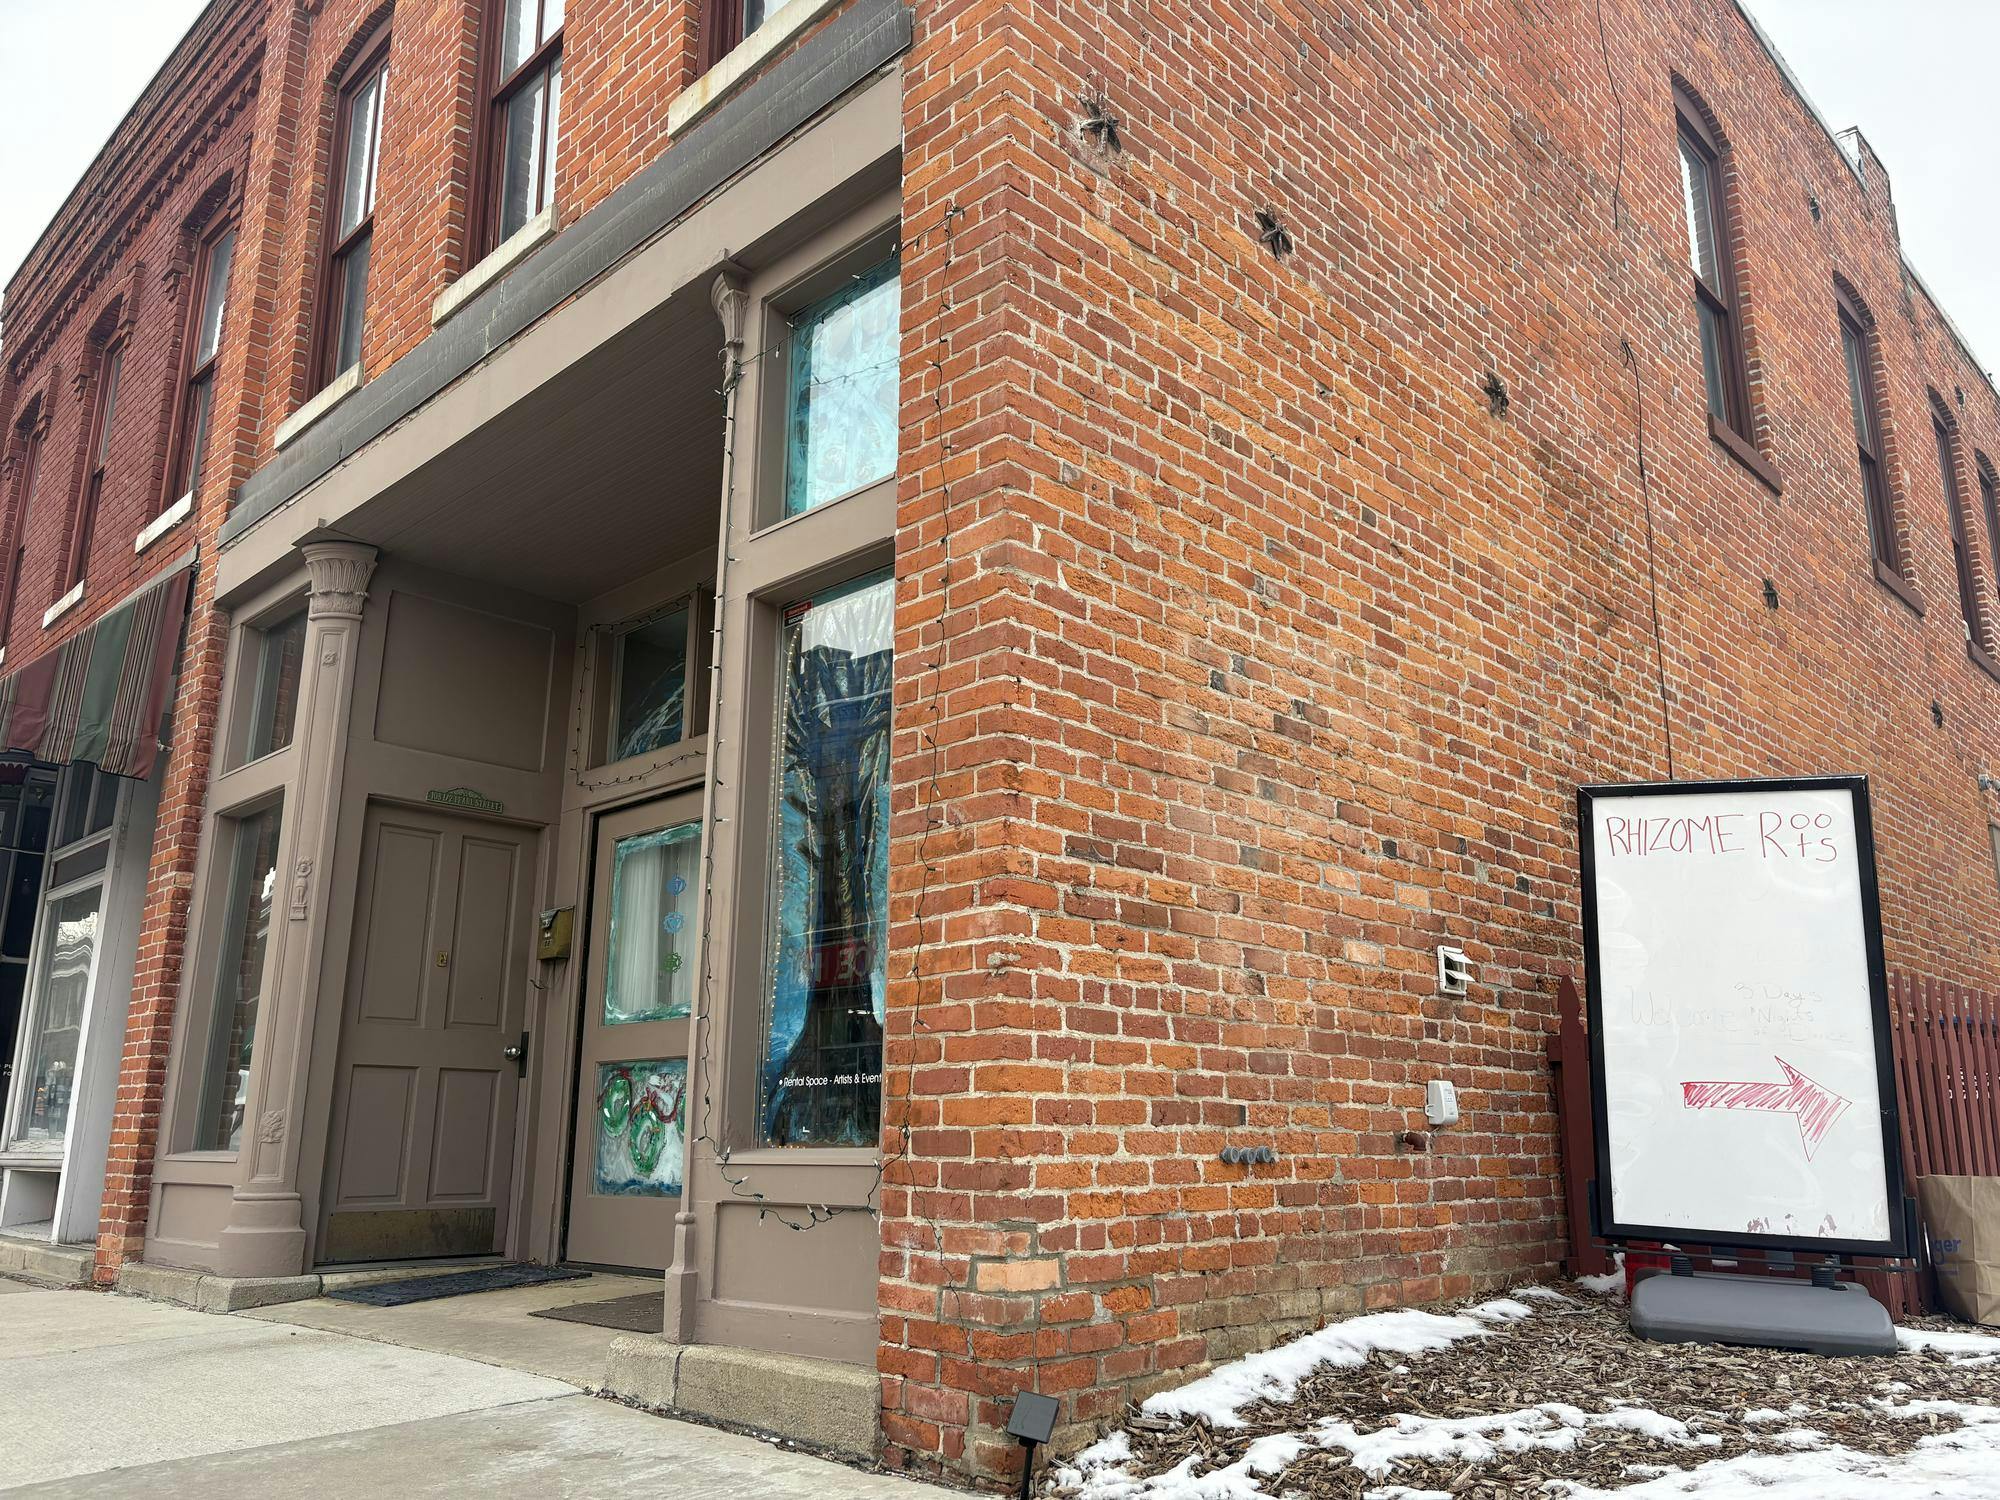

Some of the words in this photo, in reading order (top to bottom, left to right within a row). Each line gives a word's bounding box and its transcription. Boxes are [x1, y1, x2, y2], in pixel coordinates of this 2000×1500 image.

[474, 798, 499, 810] STREET
[1606, 814, 1745, 856] RHIZOME
[783, 1076, 805, 1087] Rental
[805, 1075, 828, 1088] Space
[833, 1074, 853, 1085] Artists
[853, 1073, 860, 1084] &
